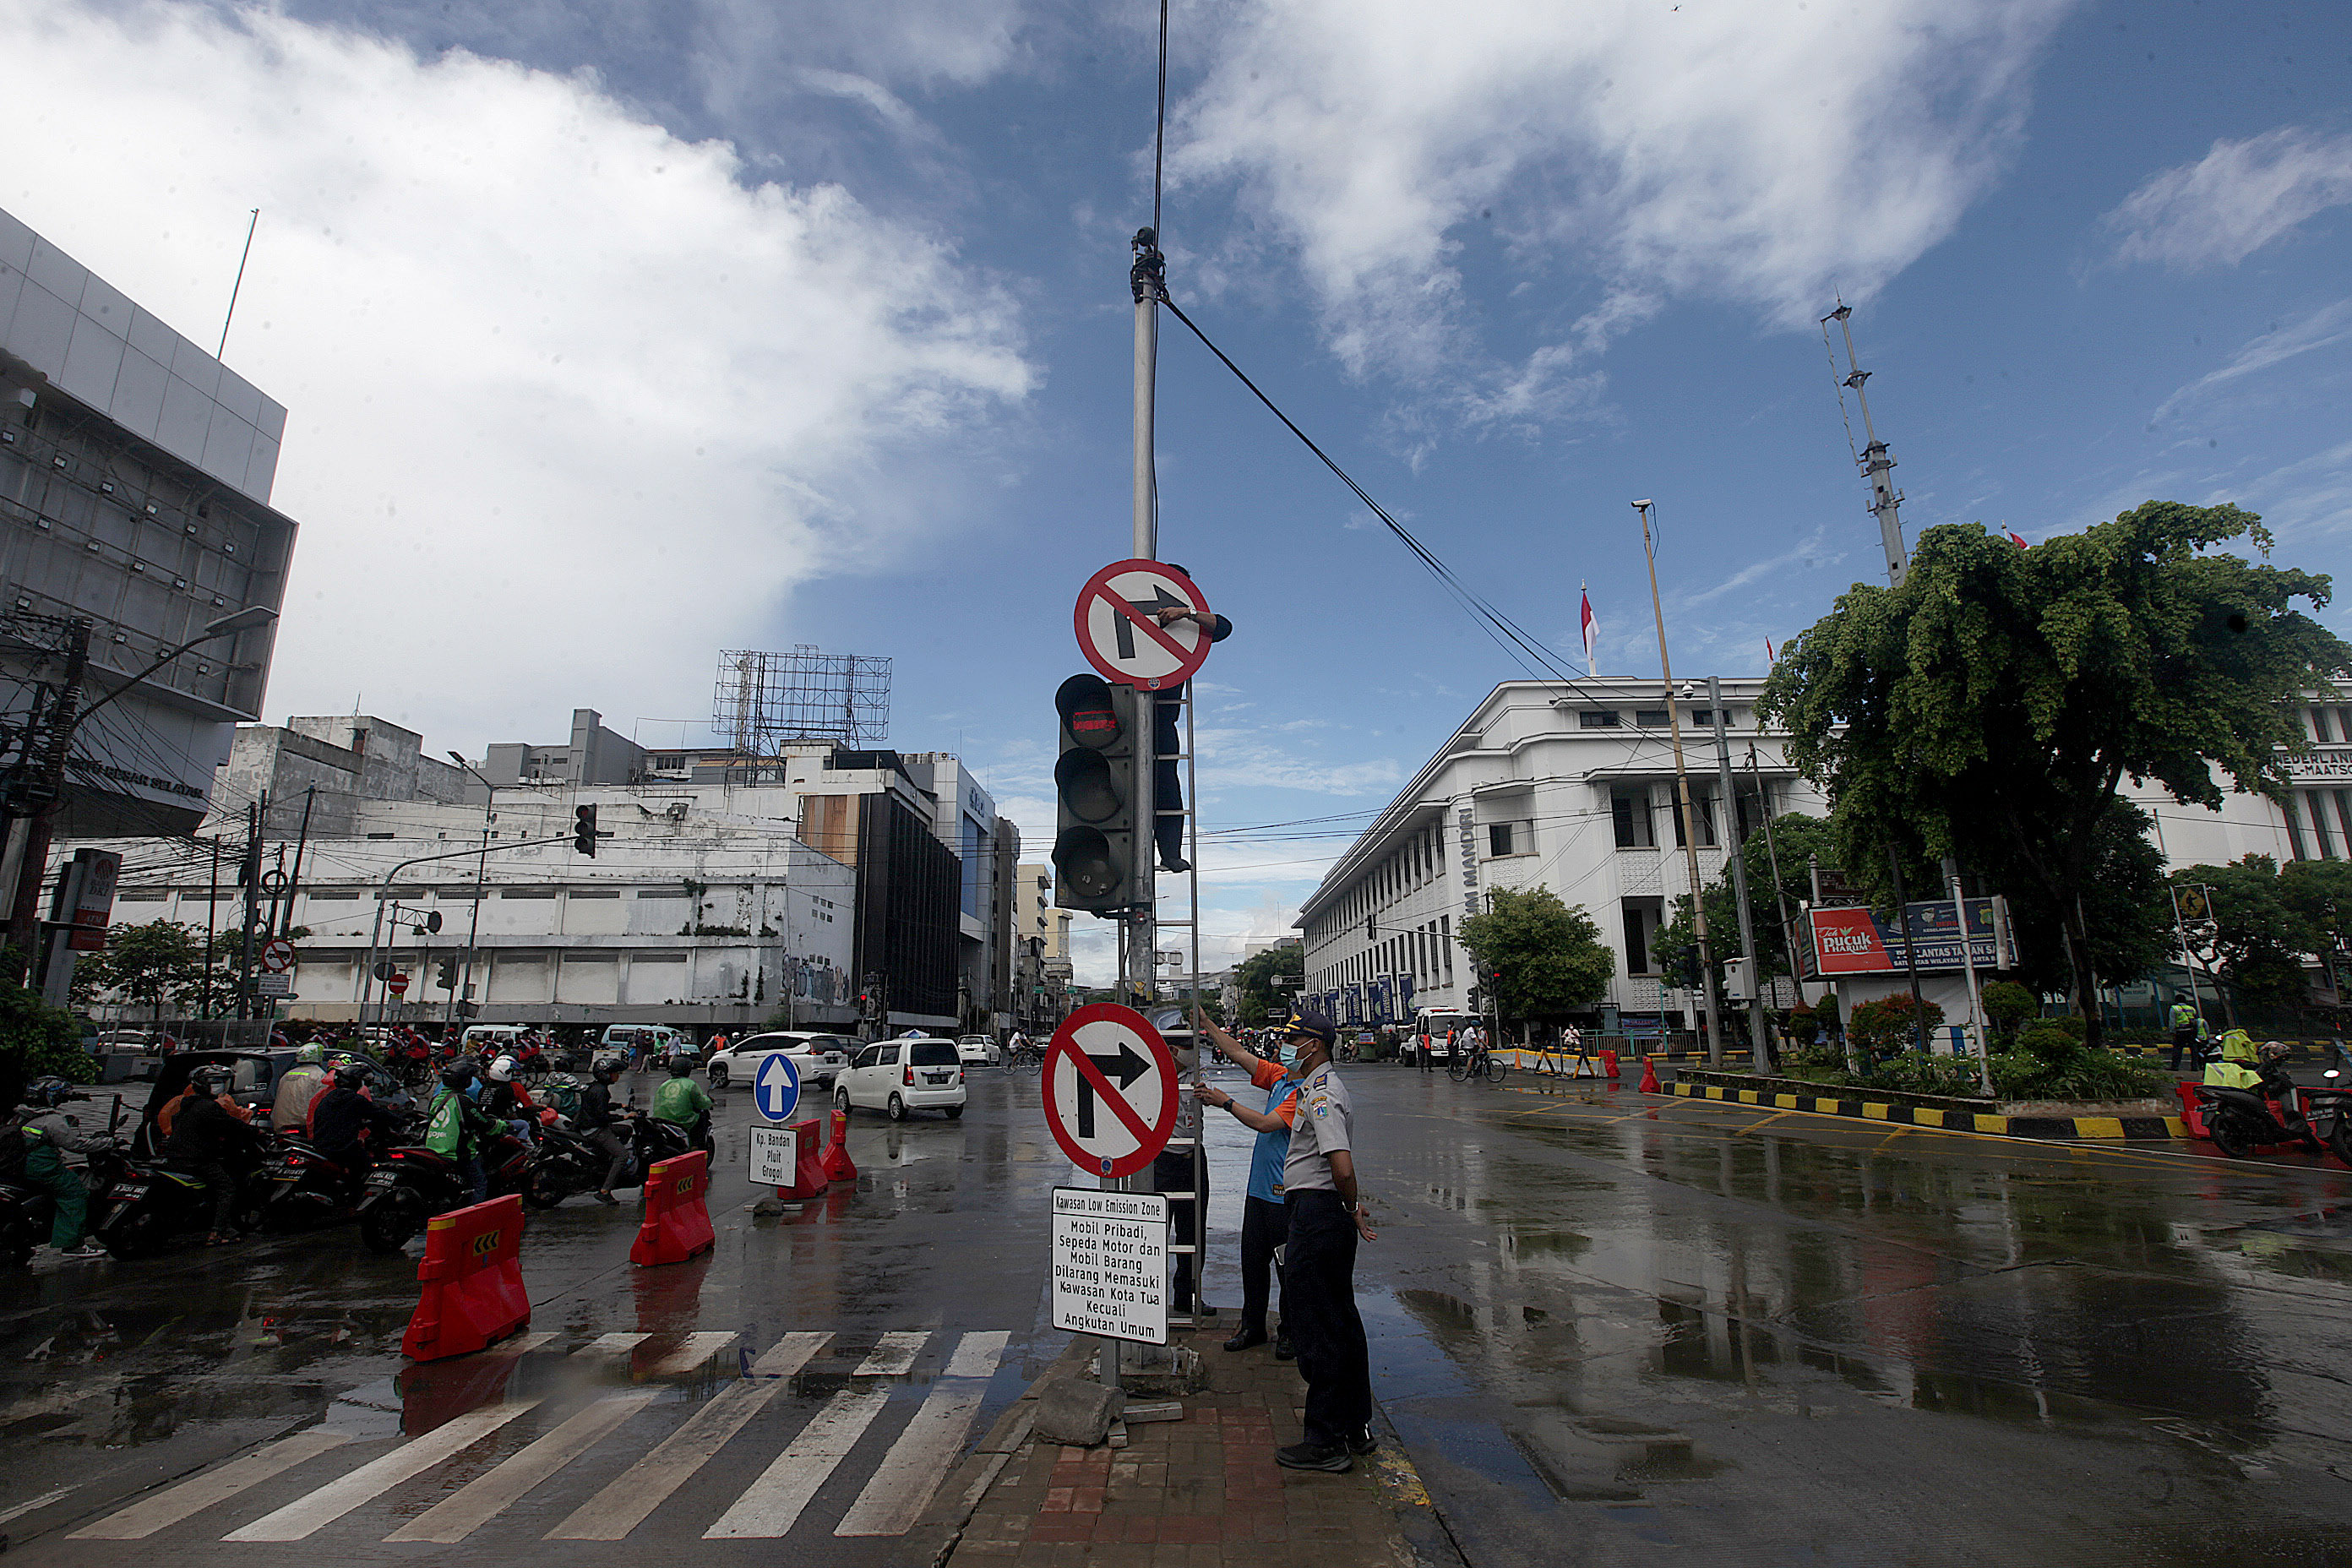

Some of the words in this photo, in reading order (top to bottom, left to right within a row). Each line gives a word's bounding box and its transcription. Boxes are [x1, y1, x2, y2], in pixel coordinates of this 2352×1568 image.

[1459, 808, 1478, 887] MANDIRI
[89, 885, 109, 897] DKI
[1832, 945, 1869, 953] HARUM
[1952, 945, 1985, 956] TAAN
[1930, 956, 1959, 966] WILAYAH
[756, 1133, 765, 1147] Kp.
[769, 1134, 790, 1147] Bandan
[767, 1150, 781, 1163] Pluit
[762, 1165, 782, 1182] Grogol
[1056, 1195, 1086, 1211] Kawasan
[1088, 1198, 1102, 1212] Low
[1106, 1199, 1138, 1215] Emission
[1141, 1201, 1160, 1217] Zone
[1070, 1221, 1099, 1235] Mobil
[1104, 1223, 1147, 1241] Pribadi,
[1059, 1235, 1097, 1250] Sepeda
[1102, 1239, 1134, 1253] Motor
[1140, 1242, 1160, 1256] dan
[1070, 1251, 1099, 1266] Mobil
[1104, 1255, 1142, 1273] Barang
[1055, 1265, 1099, 1284] Dilarang
[1104, 1271, 1159, 1289] Memasuki
[1060, 1281, 1104, 1298] Kawasan
[1110, 1288, 1135, 1302] Kota
[1140, 1291, 1160, 1305] Tua
[1086, 1300, 1126, 1317] Kecuali
[1064, 1313, 1114, 1332] Angkutan
[1120, 1321, 1155, 1337] Umum
